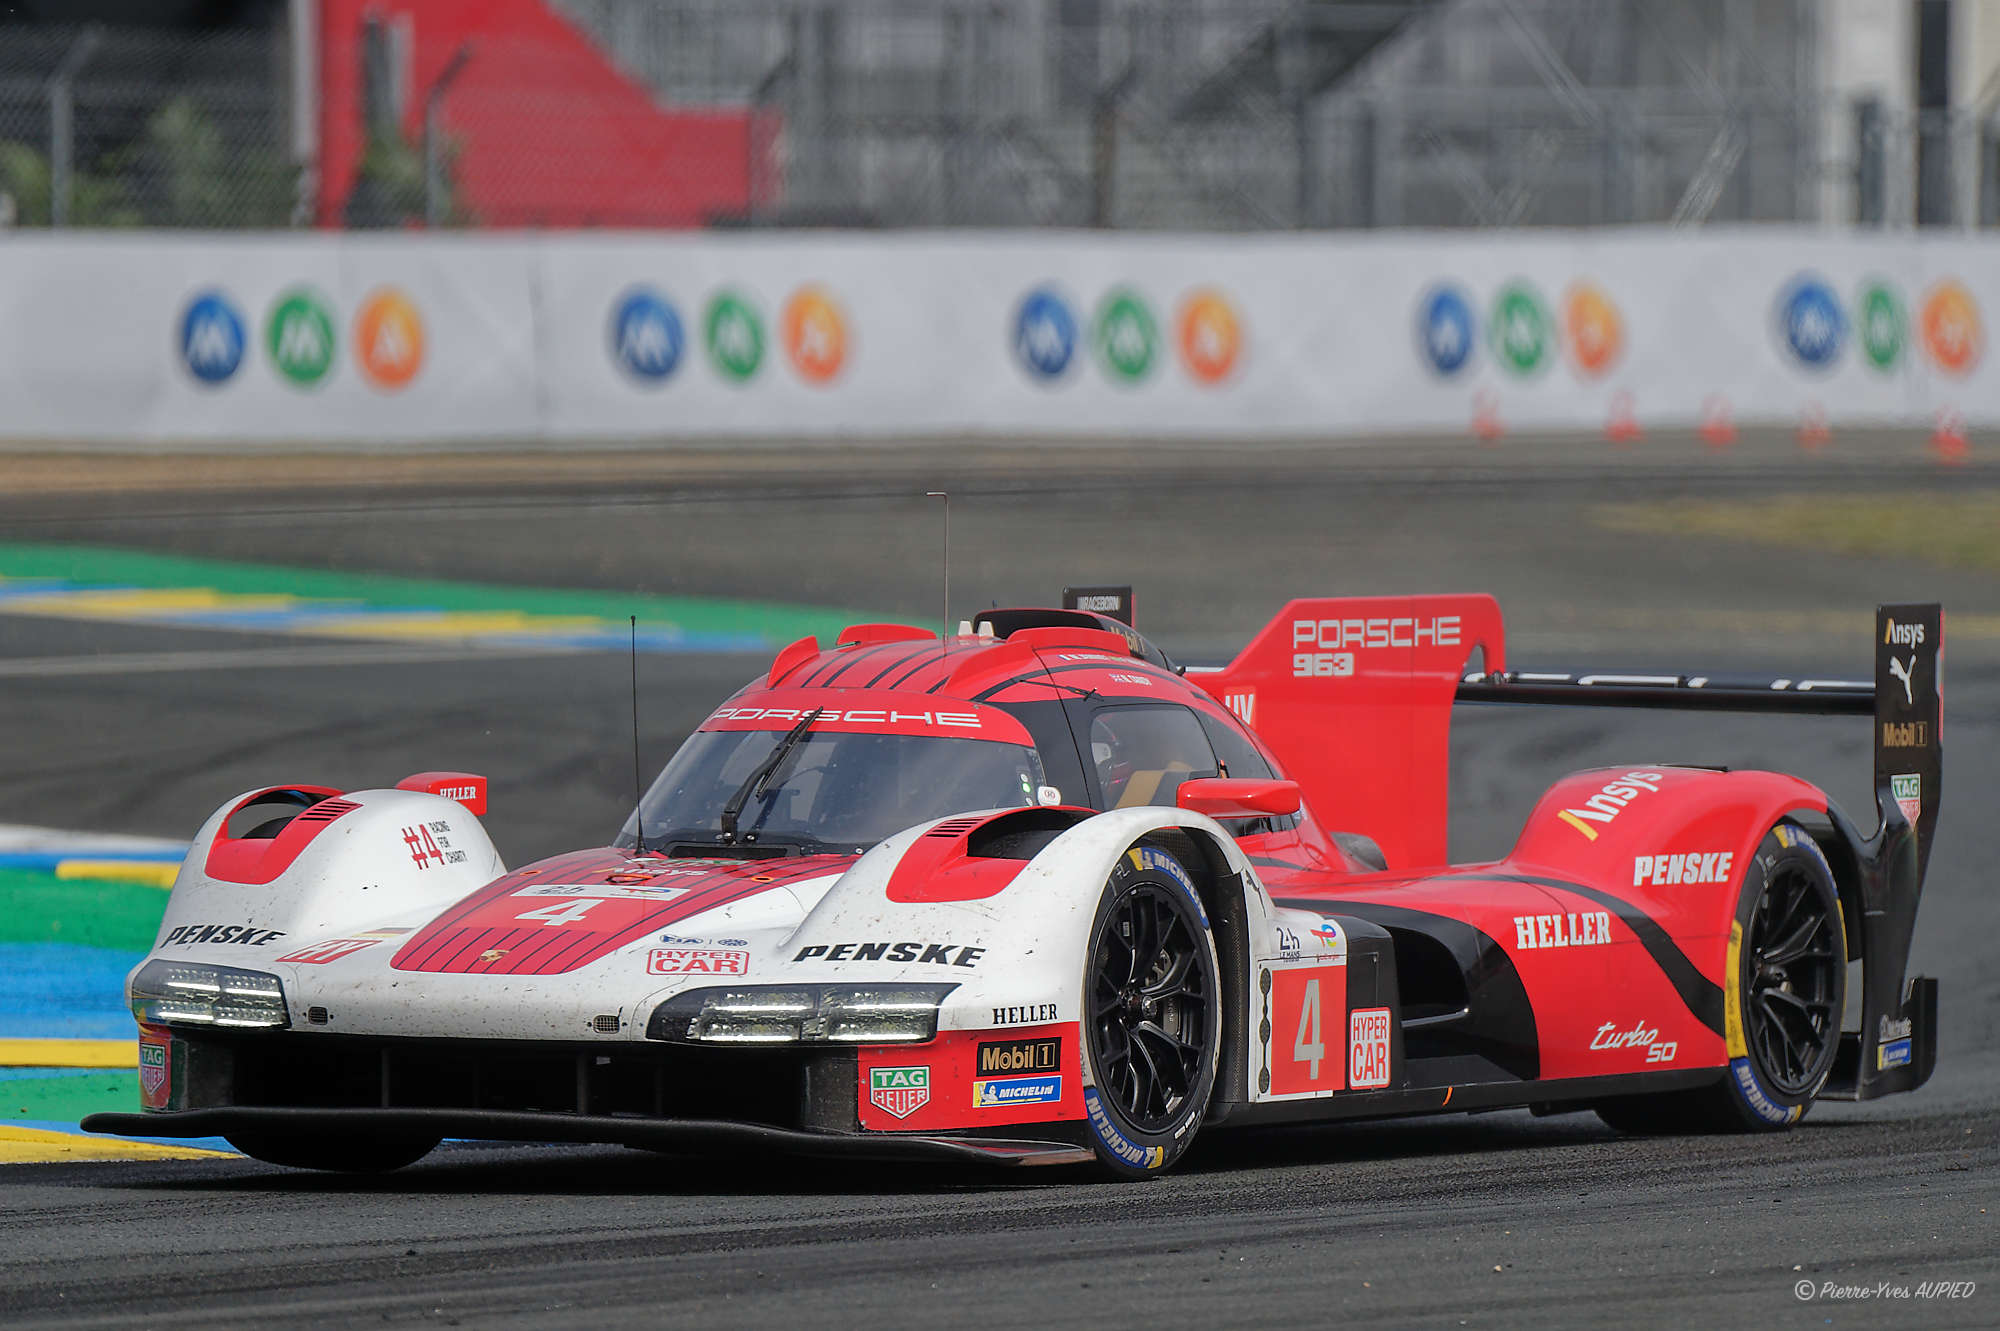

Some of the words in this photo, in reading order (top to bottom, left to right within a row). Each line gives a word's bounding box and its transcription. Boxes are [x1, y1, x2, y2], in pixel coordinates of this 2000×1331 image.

[1293, 616, 1461, 649] PORSCHE
[1886, 617, 1925, 649] Ansys
[1293, 652, 1354, 677] 963
[710, 708, 982, 728] PORSCHE
[1883, 722, 1915, 747] Mobil
[440, 786, 477, 801] HELLER
[1895, 779, 1918, 796] TAG
[1557, 771, 1663, 841] Ansys
[401, 823, 445, 870] #4
[1633, 852, 1733, 886] PENSKE
[514, 899, 605, 926] 4
[160, 924, 287, 949] PENSKE
[1513, 911, 1612, 949] HELLER
[654, 958, 741, 973] CAR
[656, 950, 741, 960] HYPER
[792, 942, 986, 968] PENSKE
[992, 1003, 1058, 1025] HELLER
[1294, 978, 1326, 1081] 4
[1353, 1015, 1387, 1041] HYPER
[1590, 1020, 1659, 1050] turbo
[142, 1047, 163, 1065] TAG
[982, 1044, 1035, 1071] Mobil
[1353, 1042, 1386, 1081] CAR
[1645, 1042, 1678, 1063] 50
[875, 1071, 925, 1087] TAG
[998, 1085, 1054, 1098] MICHELIN
[873, 1090, 926, 1114] HEUER
[1086, 1096, 1144, 1164] MICHELIN
